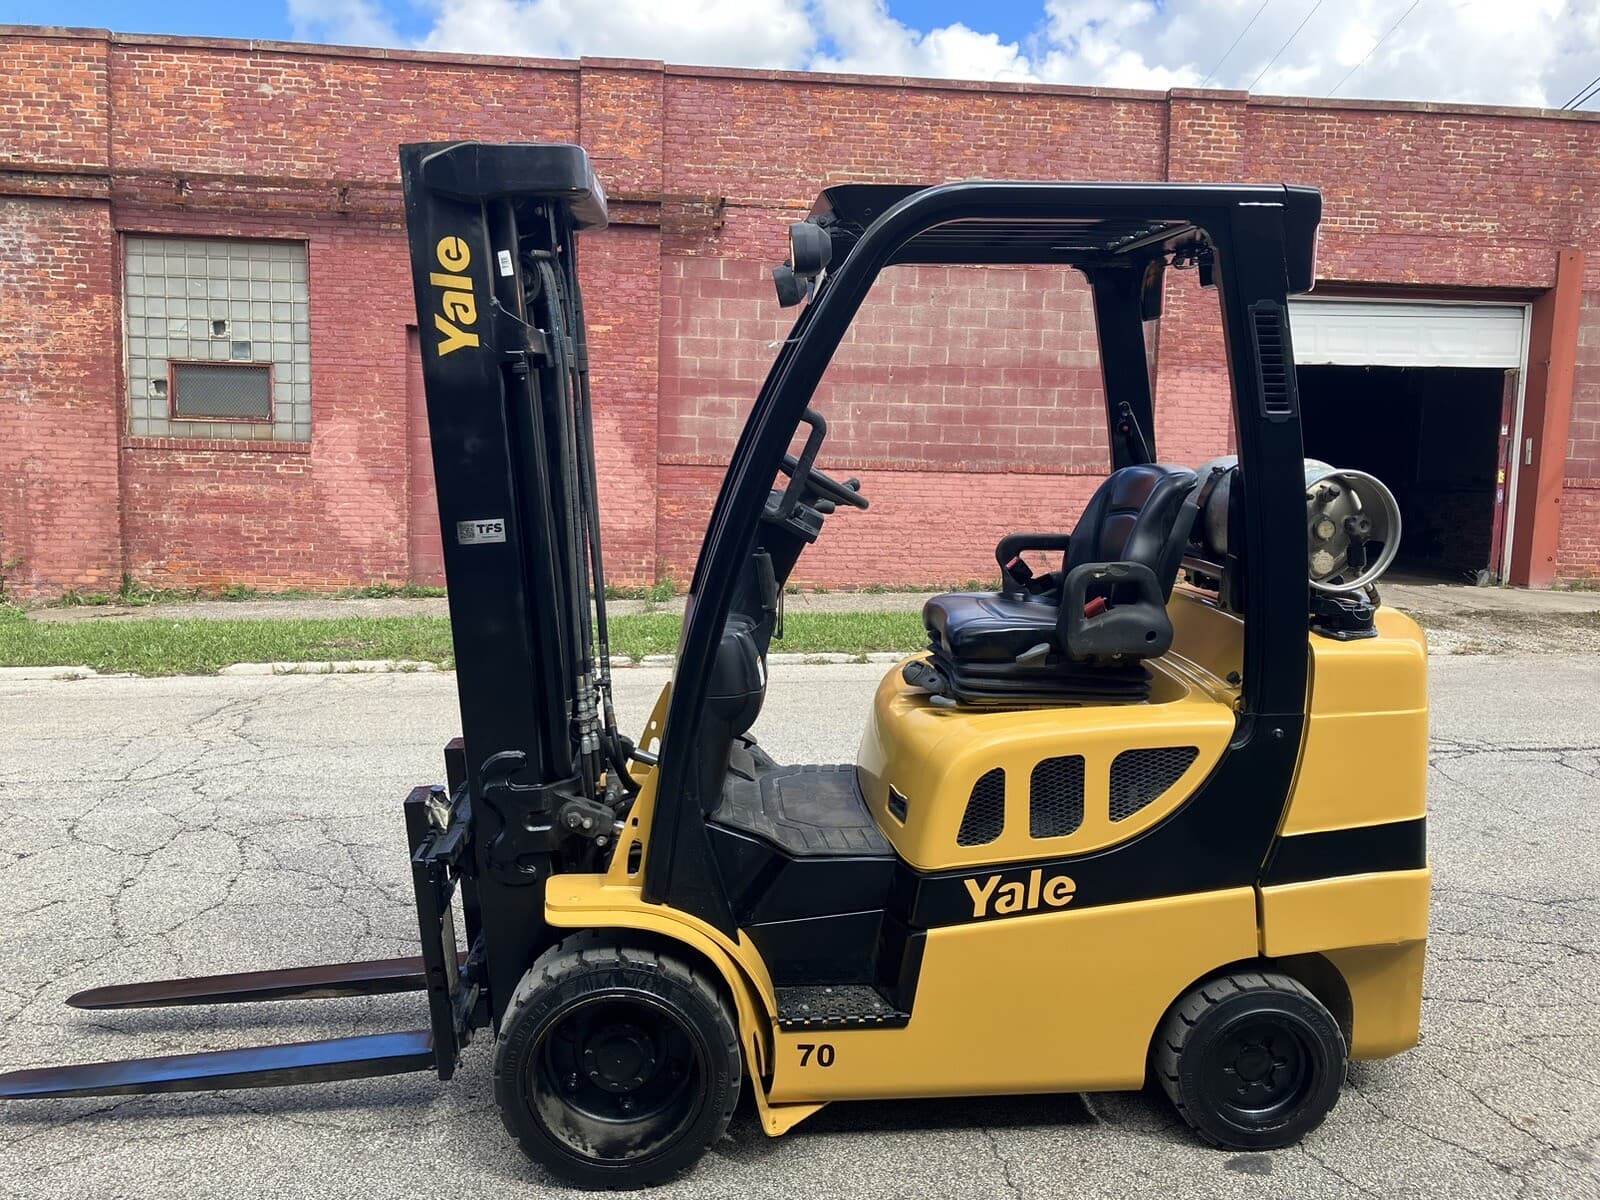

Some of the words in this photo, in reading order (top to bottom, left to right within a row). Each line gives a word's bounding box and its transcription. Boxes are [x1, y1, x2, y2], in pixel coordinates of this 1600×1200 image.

[430, 236, 479, 356] Yale
[476, 523, 502, 533] TFS
[963, 869, 1076, 917] Yale
[797, 1044, 835, 1066] 70
